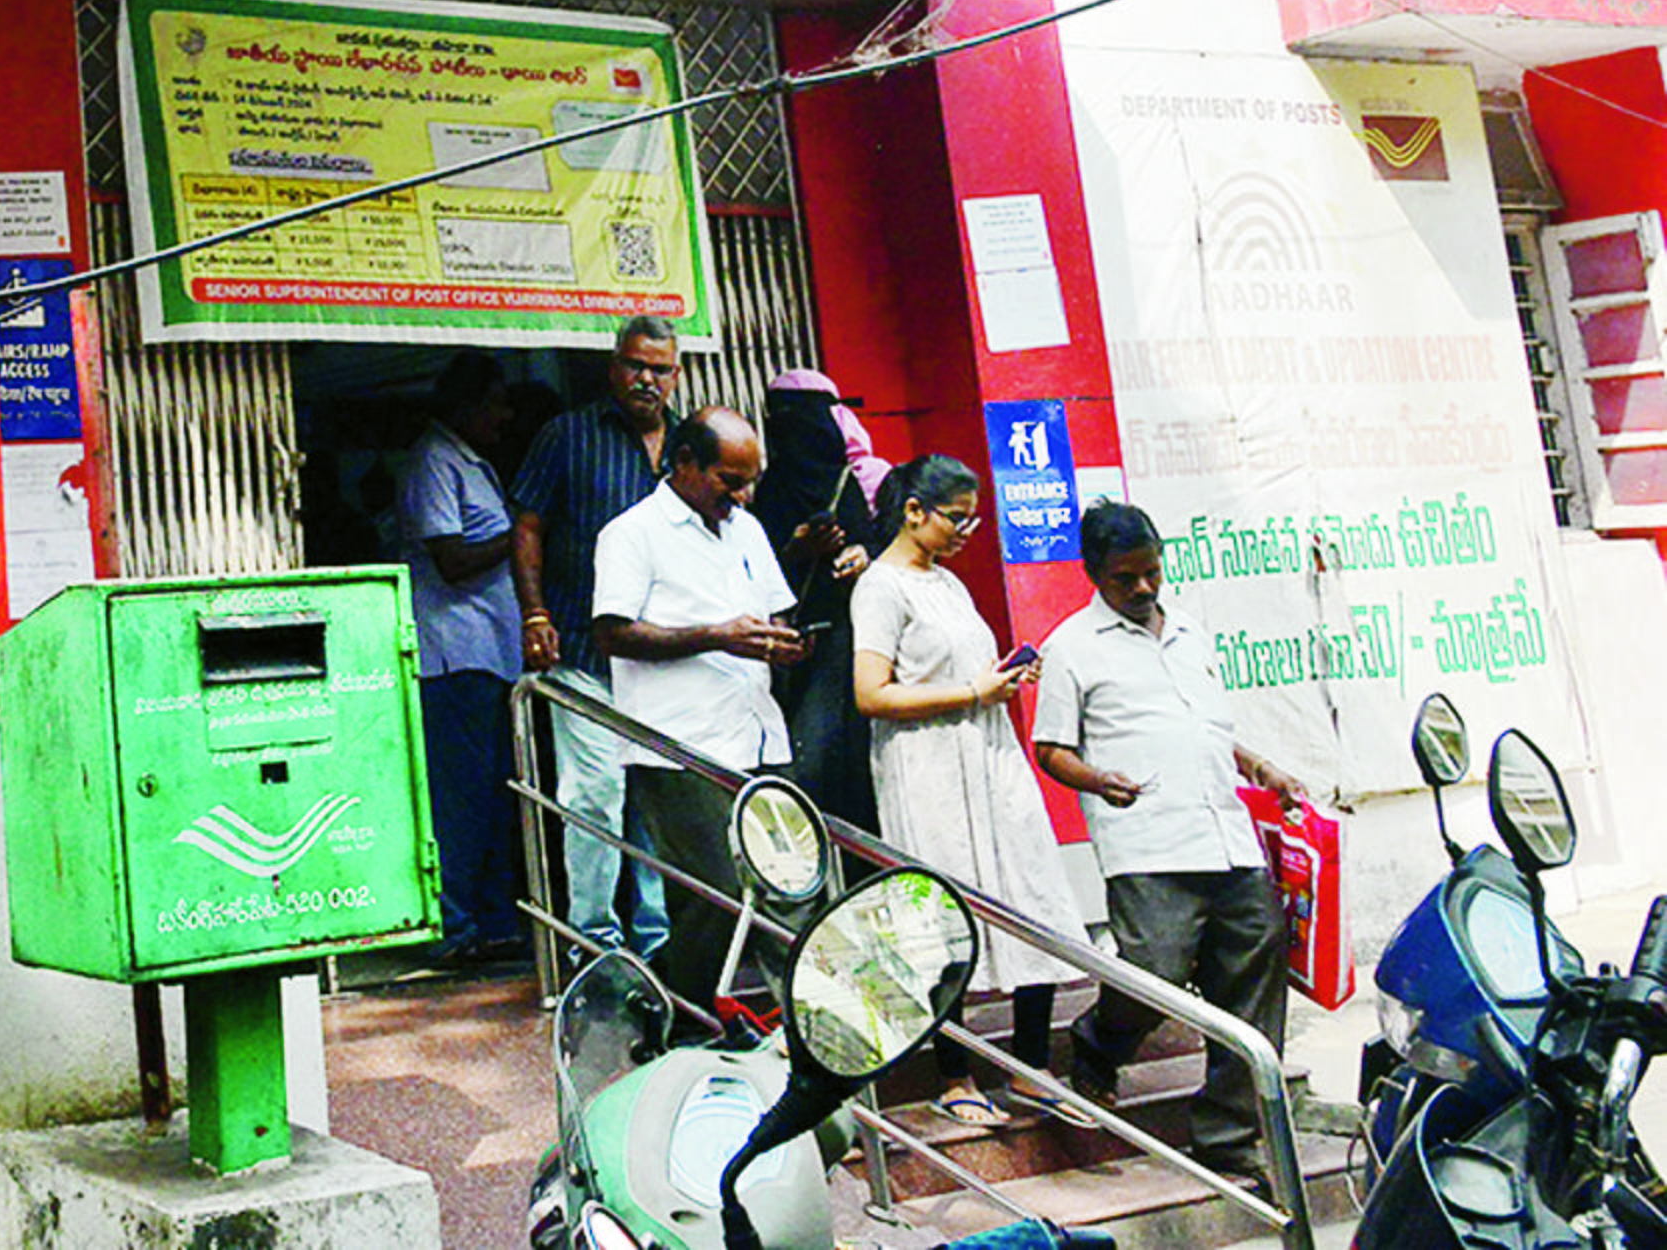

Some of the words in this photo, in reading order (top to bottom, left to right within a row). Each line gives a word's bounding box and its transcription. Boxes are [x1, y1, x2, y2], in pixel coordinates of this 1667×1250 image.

[1120, 94, 1246, 121] DEPARTMENT
[1253, 99, 1277, 121] OF
[1282, 99, 1342, 126] POSTS
[205, 283, 261, 299] SENIOR
[264, 284, 388, 301] SUPERINTENDENT
[391, 288, 410, 302] OF
[414, 288, 449, 304] POST
[452, 290, 500, 306] OFFICE
[0, 362, 50, 379] ACCESS
[1322, 335, 1421, 385] UPDATION
[1422, 334, 1498, 383] CENTRE
[1005, 481, 1069, 502] ENTRANCE
[1161, 515, 1215, 595] ధార్
[1430, 577, 1547, 683] మాత్రమే
[285, 890, 324, 914] 520
